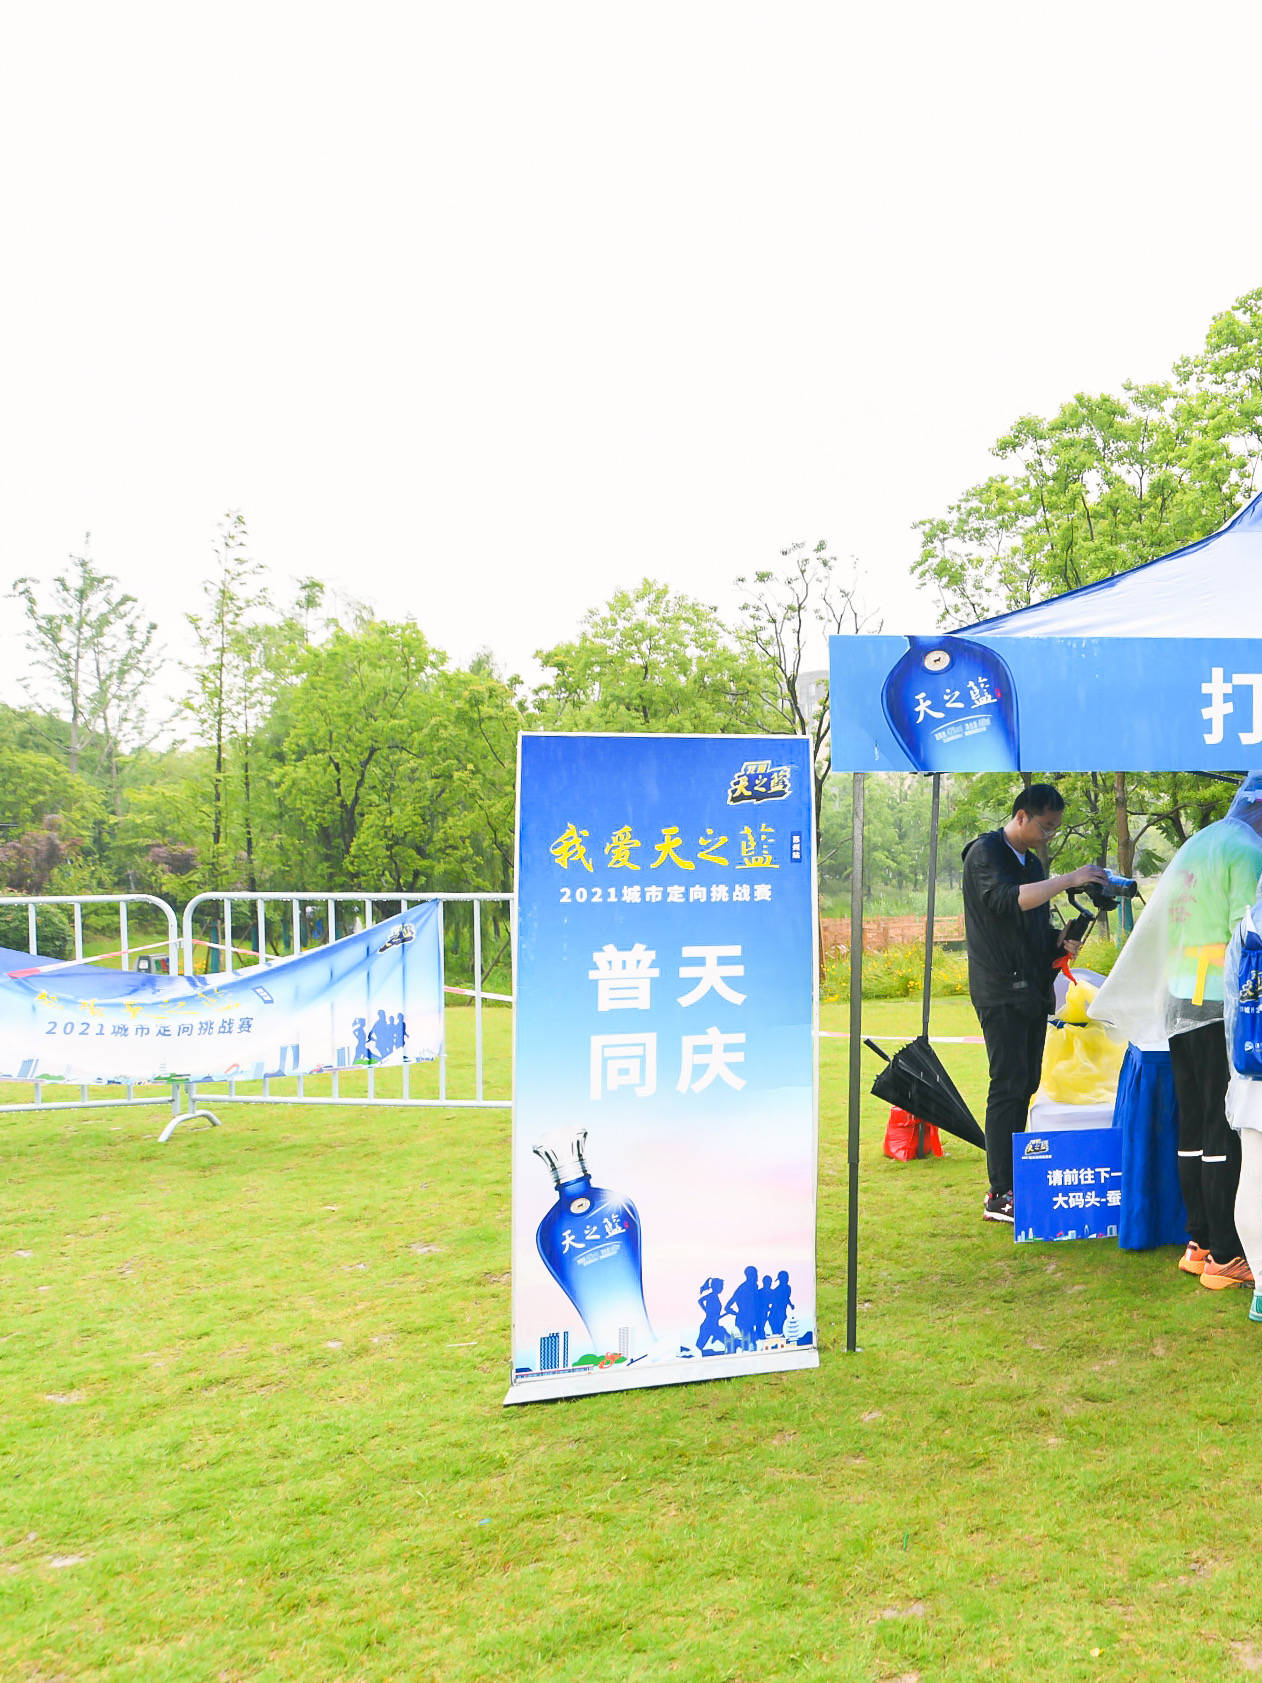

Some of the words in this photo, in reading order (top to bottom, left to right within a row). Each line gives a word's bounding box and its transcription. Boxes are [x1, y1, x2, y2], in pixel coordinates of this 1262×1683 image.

[559, 883, 773, 903] 2021城市定向挑战赛
[588, 943, 748, 1012] 普天
[588, 1026, 748, 1101] 同庆
[1047, 1167, 1123, 1187] 请前往下一
